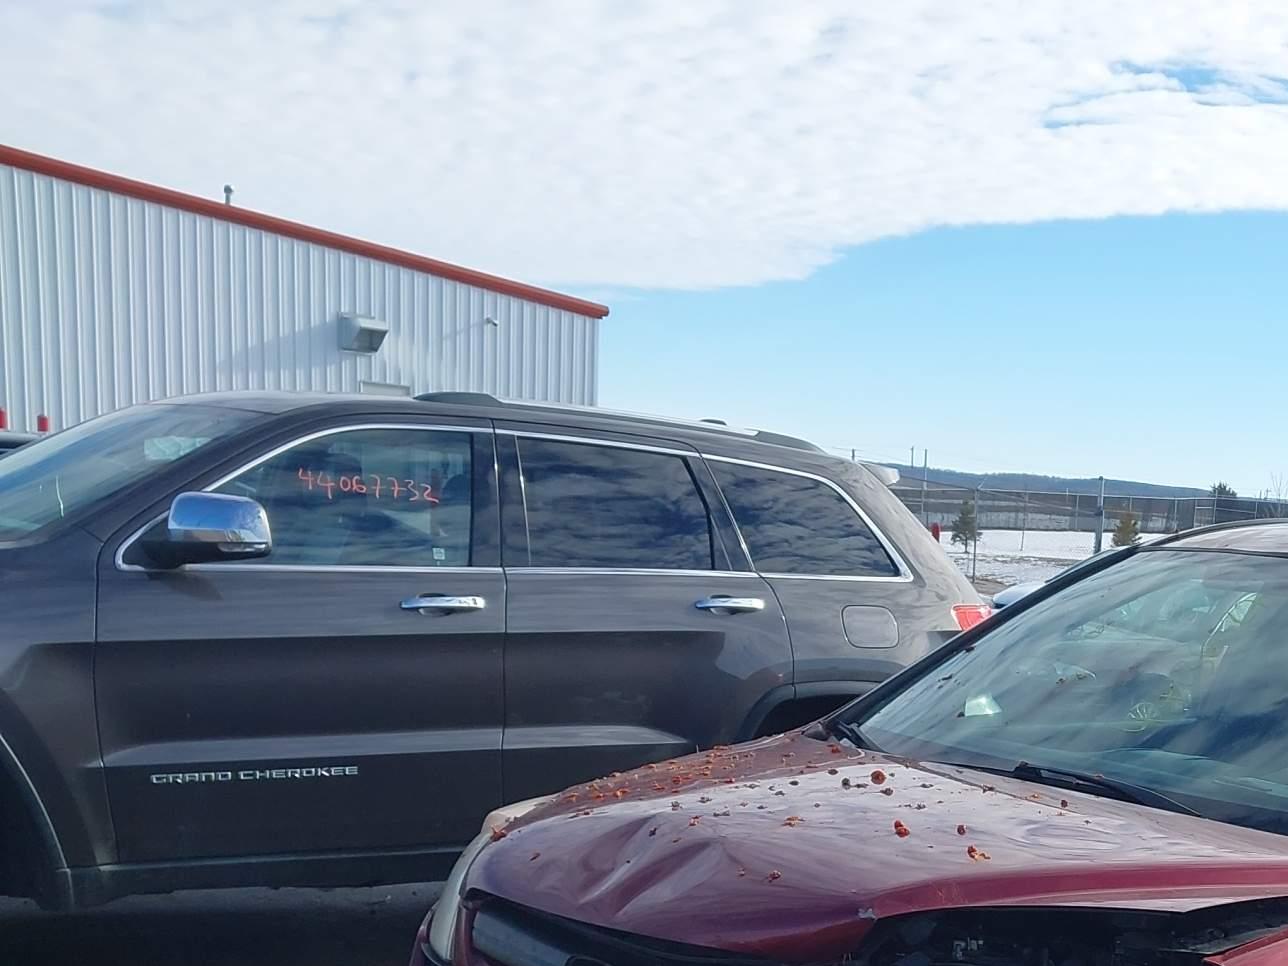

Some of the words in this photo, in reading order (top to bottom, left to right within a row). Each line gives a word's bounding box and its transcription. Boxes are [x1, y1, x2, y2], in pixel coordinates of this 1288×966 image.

[298, 467, 439, 503] 44067732
[151, 771, 232, 784] GRAND
[239, 766, 359, 780] CHEROKEE
